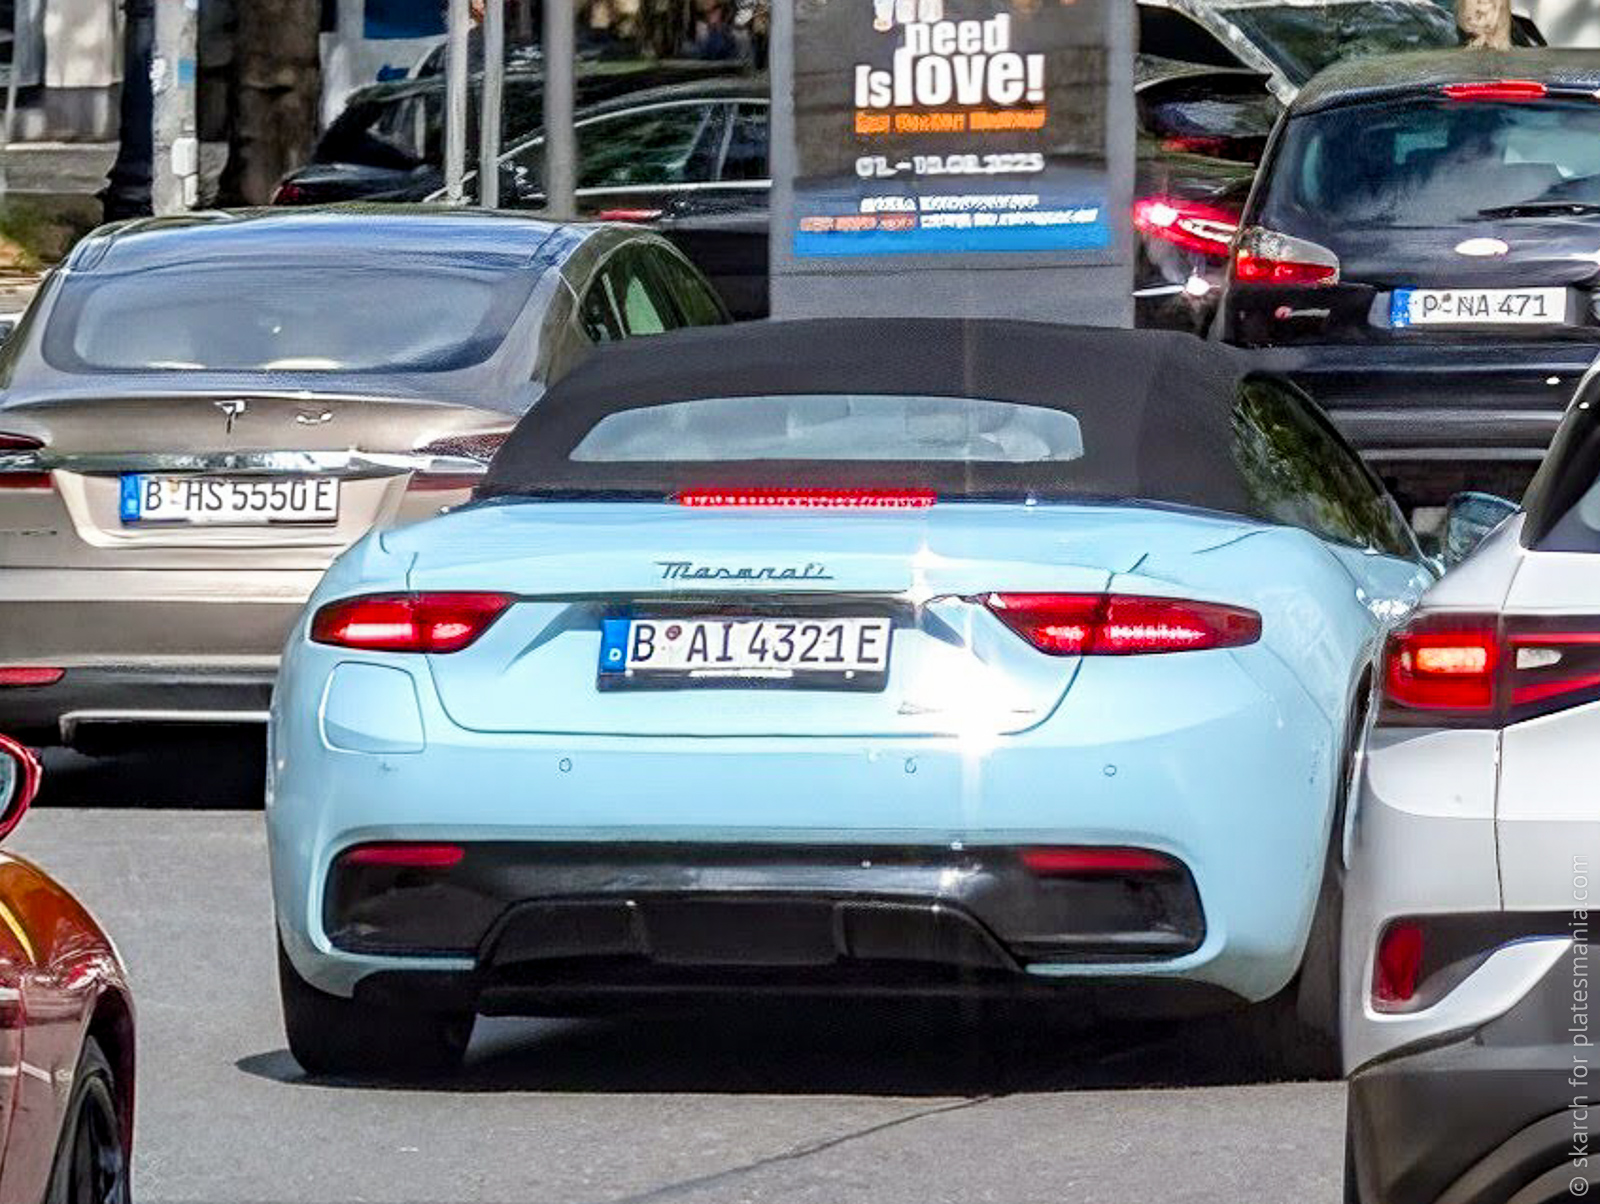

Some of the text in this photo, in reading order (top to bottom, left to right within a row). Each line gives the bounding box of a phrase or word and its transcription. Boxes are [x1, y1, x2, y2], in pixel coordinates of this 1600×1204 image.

[905, 13, 1010, 55] need
[894, 48, 1046, 106] love!
[1422, 294, 1438, 317] P
[1498, 294, 1548, 316] 471
[145, 480, 162, 511] B
[654, 561, 834, 580] Maserati
[630, 624, 657, 663] B
[686, 623, 734, 662] AI
